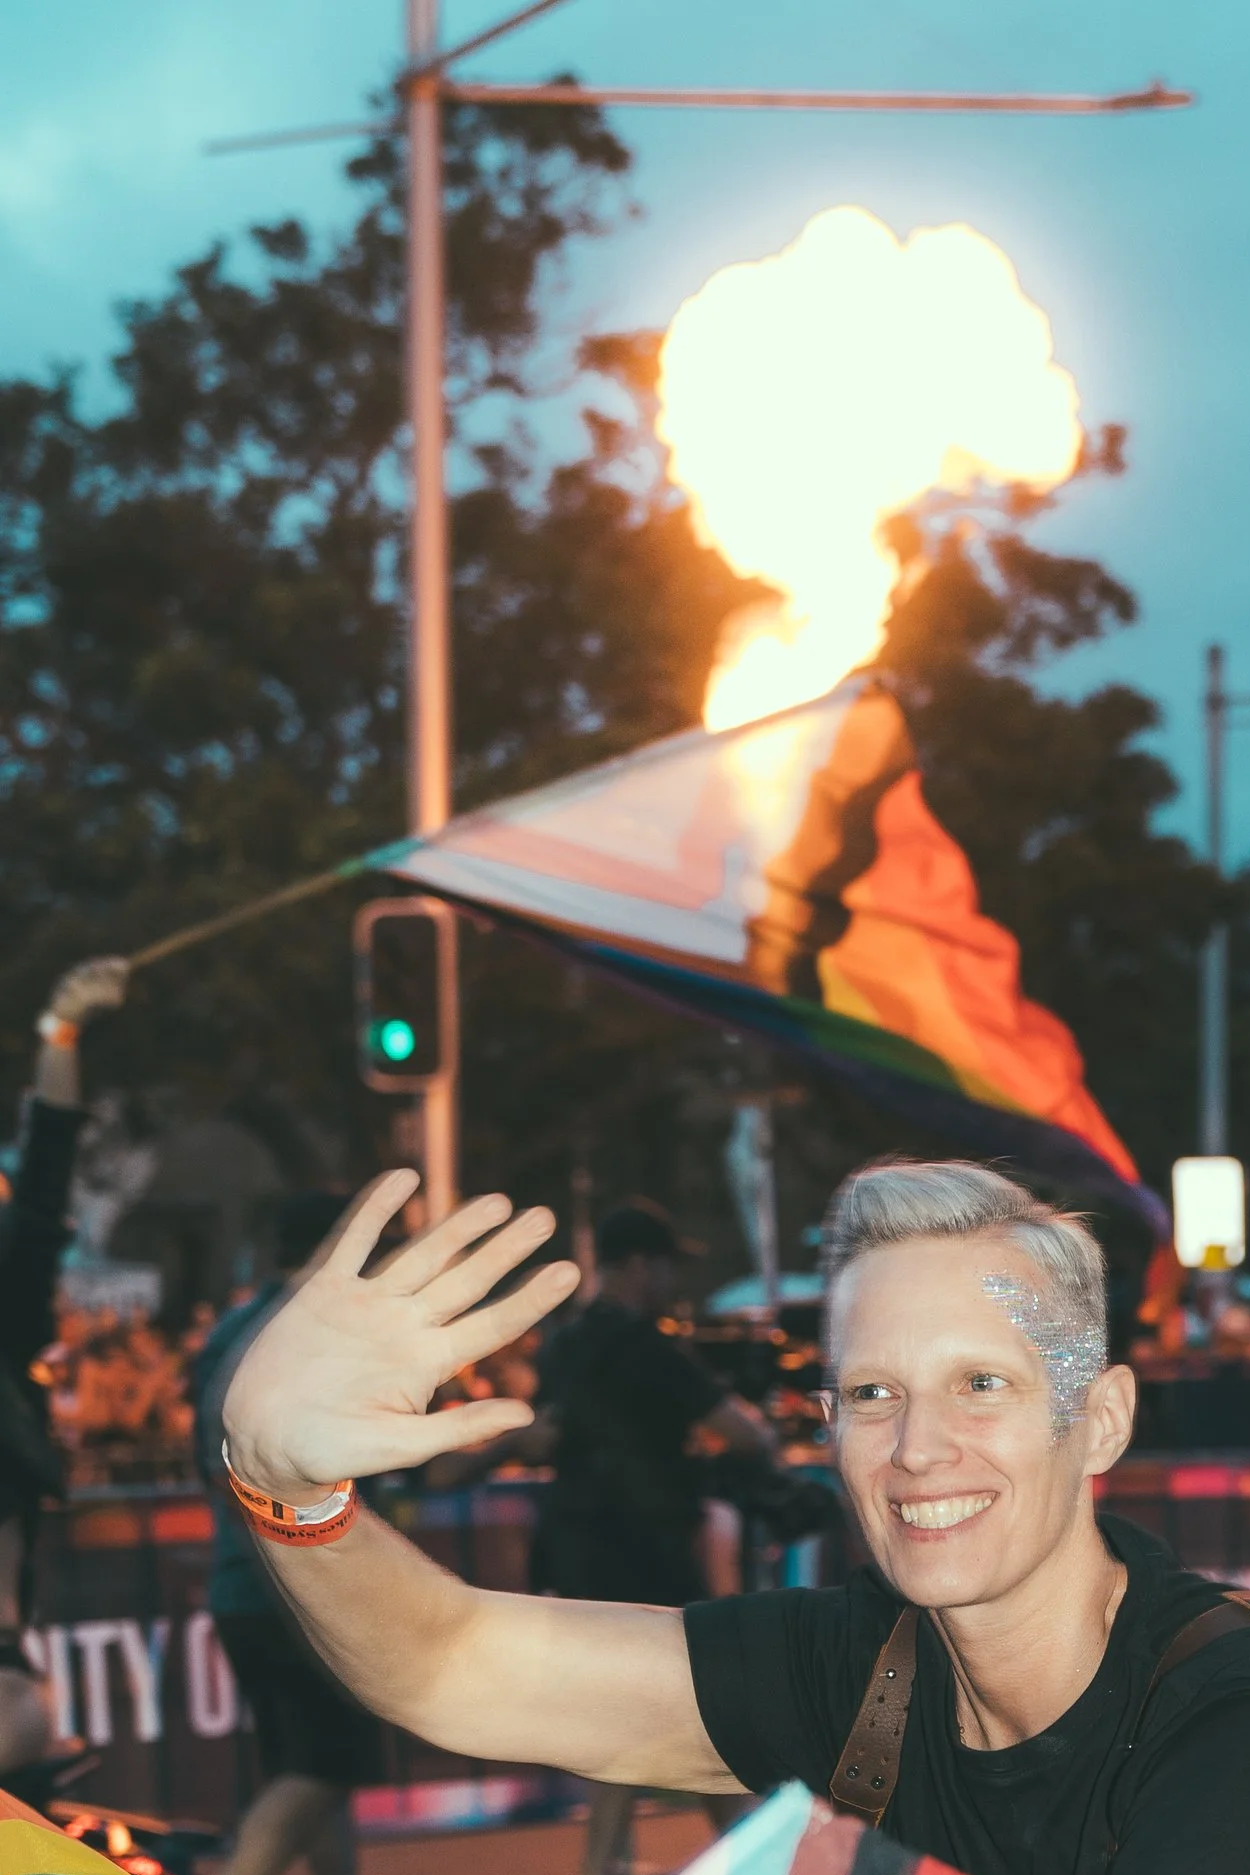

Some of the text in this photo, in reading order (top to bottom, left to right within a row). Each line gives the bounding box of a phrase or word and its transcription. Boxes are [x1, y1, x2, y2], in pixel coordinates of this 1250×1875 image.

[261, 1519, 317, 1539] Sydney
[20, 1609, 242, 1746] ITY O
